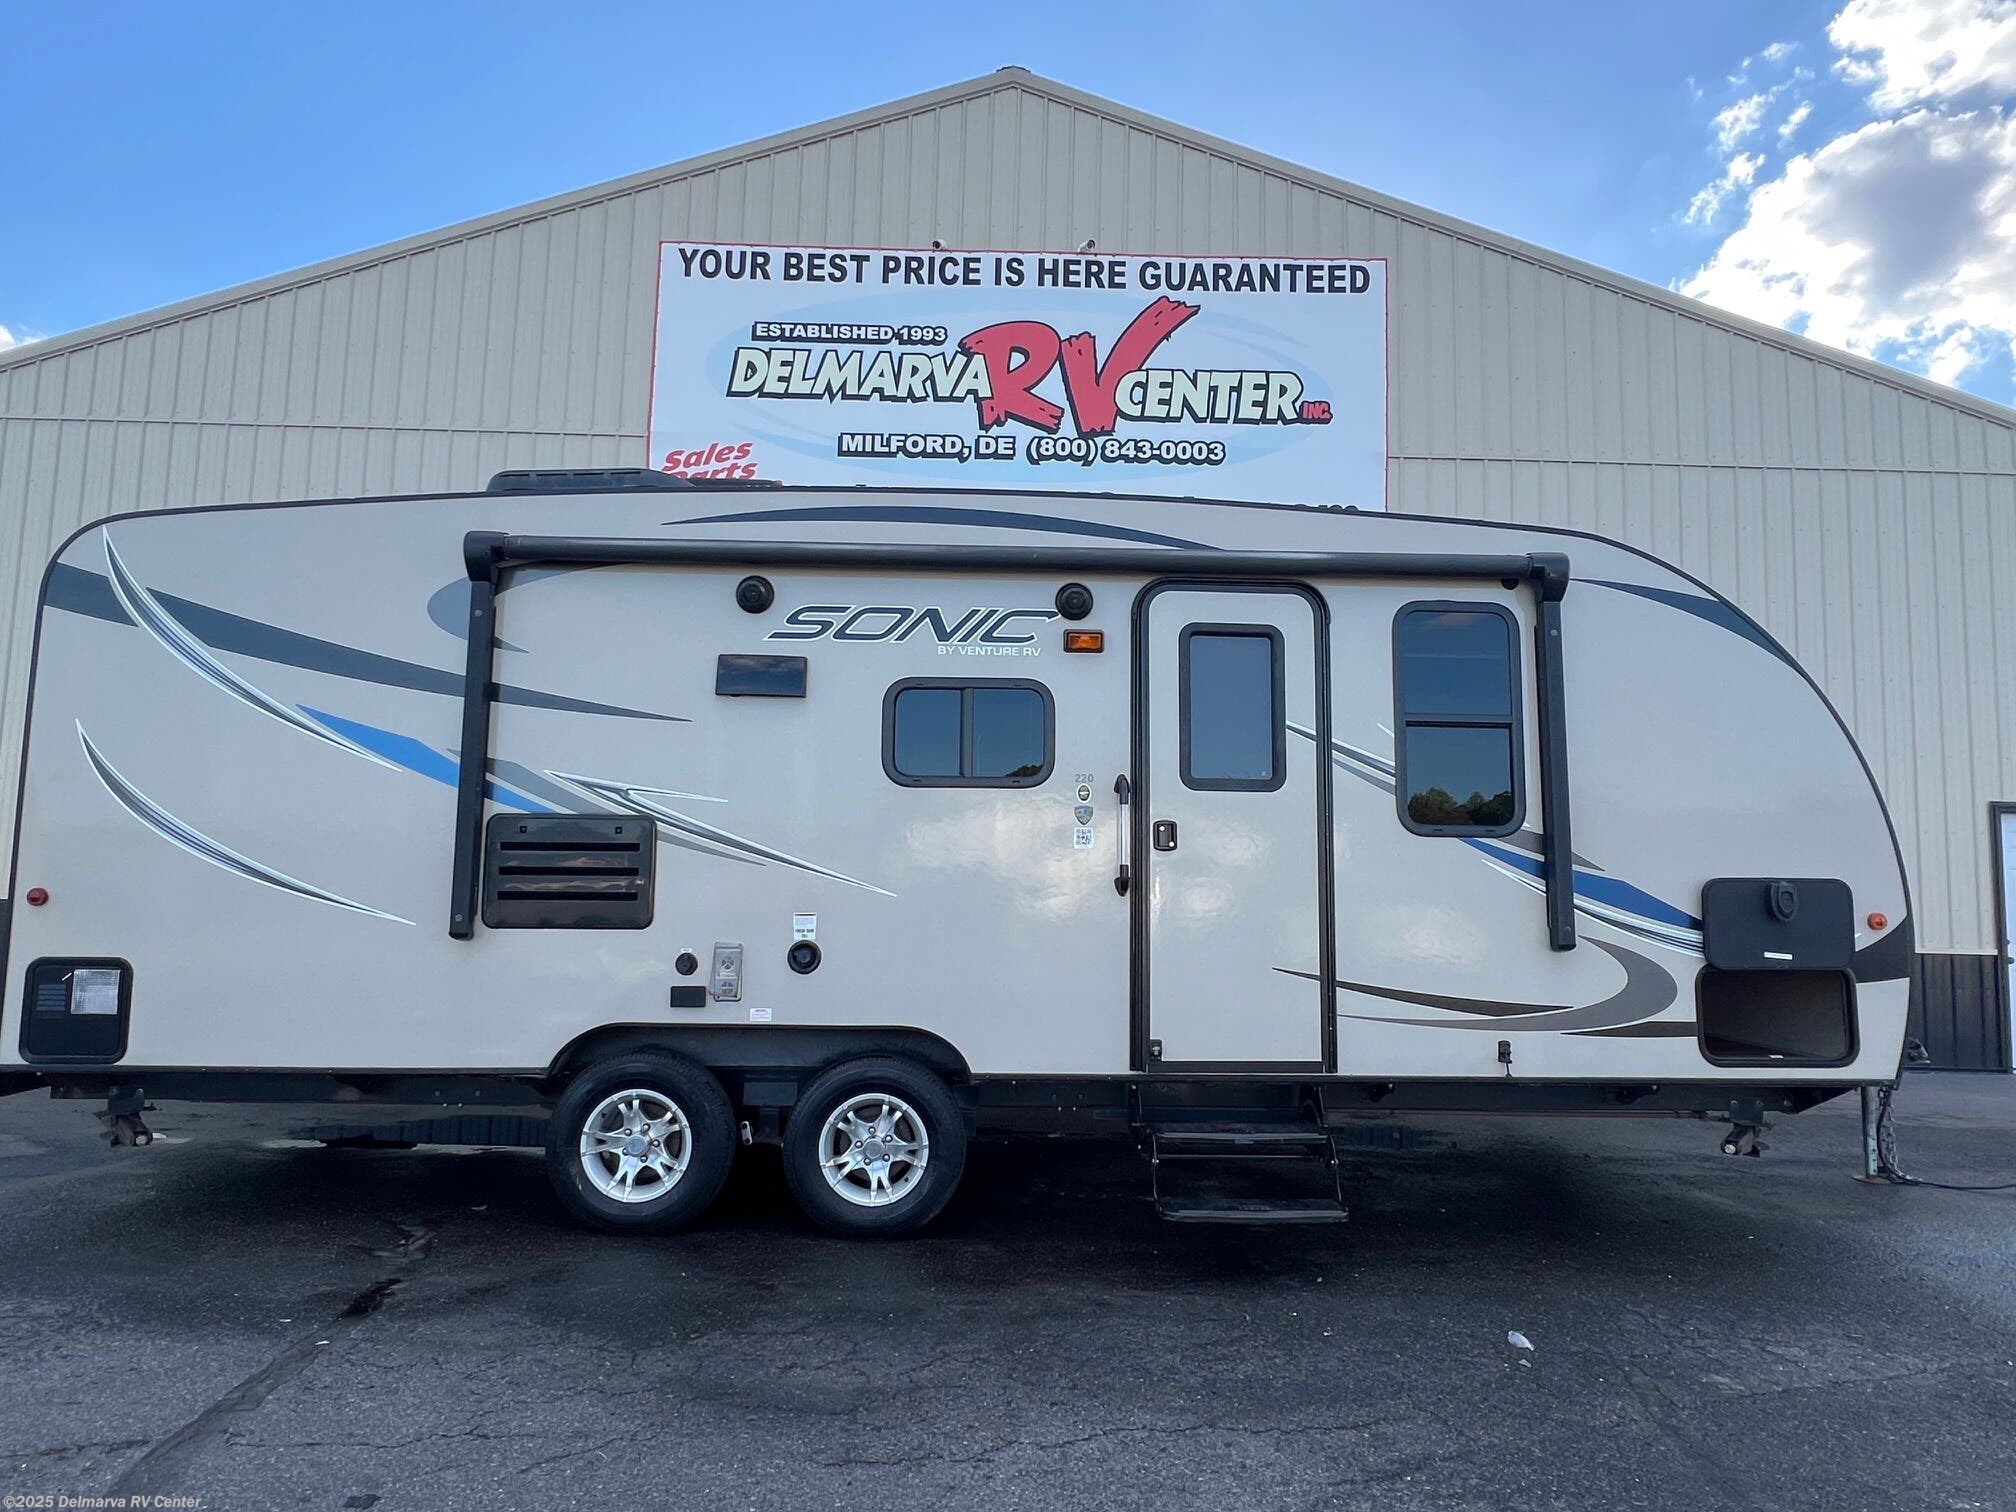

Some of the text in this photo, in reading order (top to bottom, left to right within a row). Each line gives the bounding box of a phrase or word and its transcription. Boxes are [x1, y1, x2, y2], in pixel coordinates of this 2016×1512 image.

[678, 248, 1370, 294] YOUR BEST PRICE IS HERE GUARANTEED
[752, 321, 948, 345] ESTABLISHED 1993
[726, 295, 1333, 438] DELMARVA RV CENTER INC.
[837, 433, 1226, 466] MILFORD, DE (800) 843-0003
[764, 604, 1060, 645] SONIC
[937, 646, 1041, 657] BY VENTURE RV
[1075, 773, 1094, 783] 220
